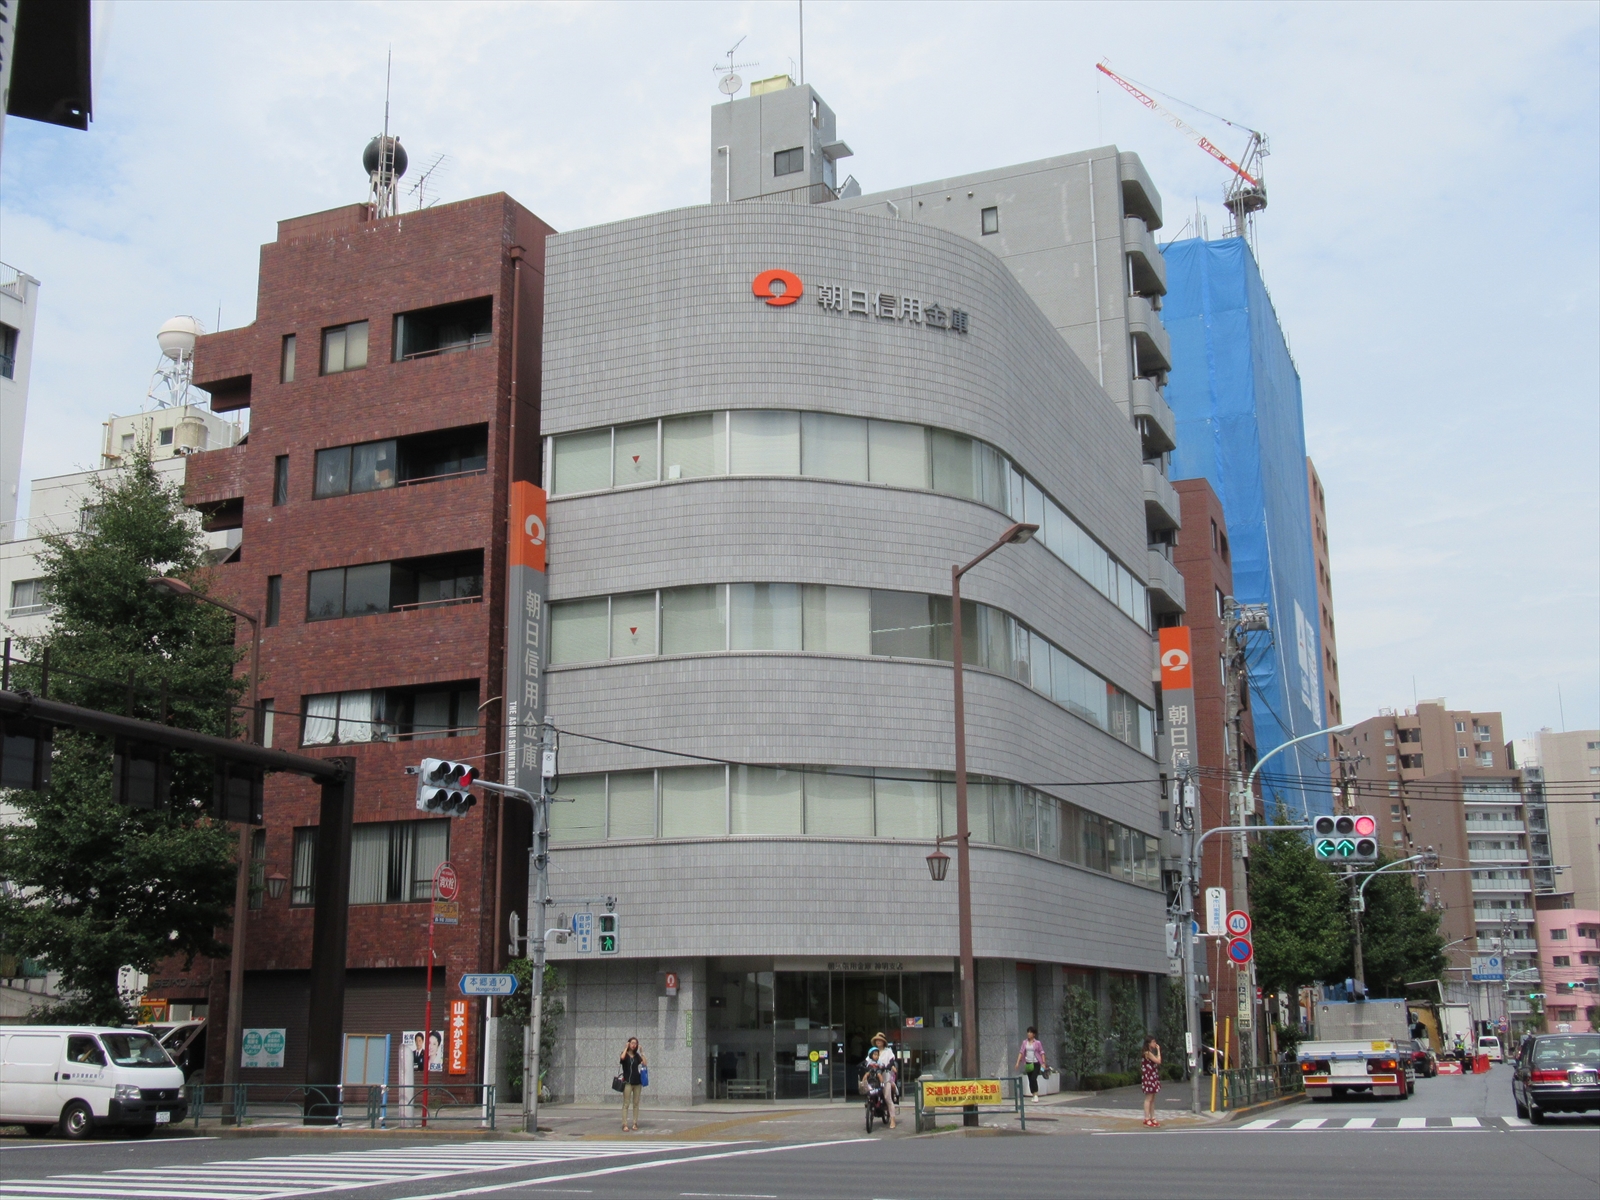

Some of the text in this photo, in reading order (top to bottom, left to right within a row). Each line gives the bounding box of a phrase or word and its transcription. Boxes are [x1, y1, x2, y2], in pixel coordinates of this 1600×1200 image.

[817, 282, 970, 334] 朝日信用金庫
[522, 589, 541, 771] 朝日信用金庫
[507, 700, 517, 788] THE ASAHI SHINKIN BAN
[1231, 917, 1246, 930] 40
[469, 977, 507, 987] 本郷通り
[453, 1001, 465, 1070] 山本かずひと
[926, 1083, 1000, 1097] 交通事故多発! 注意!
